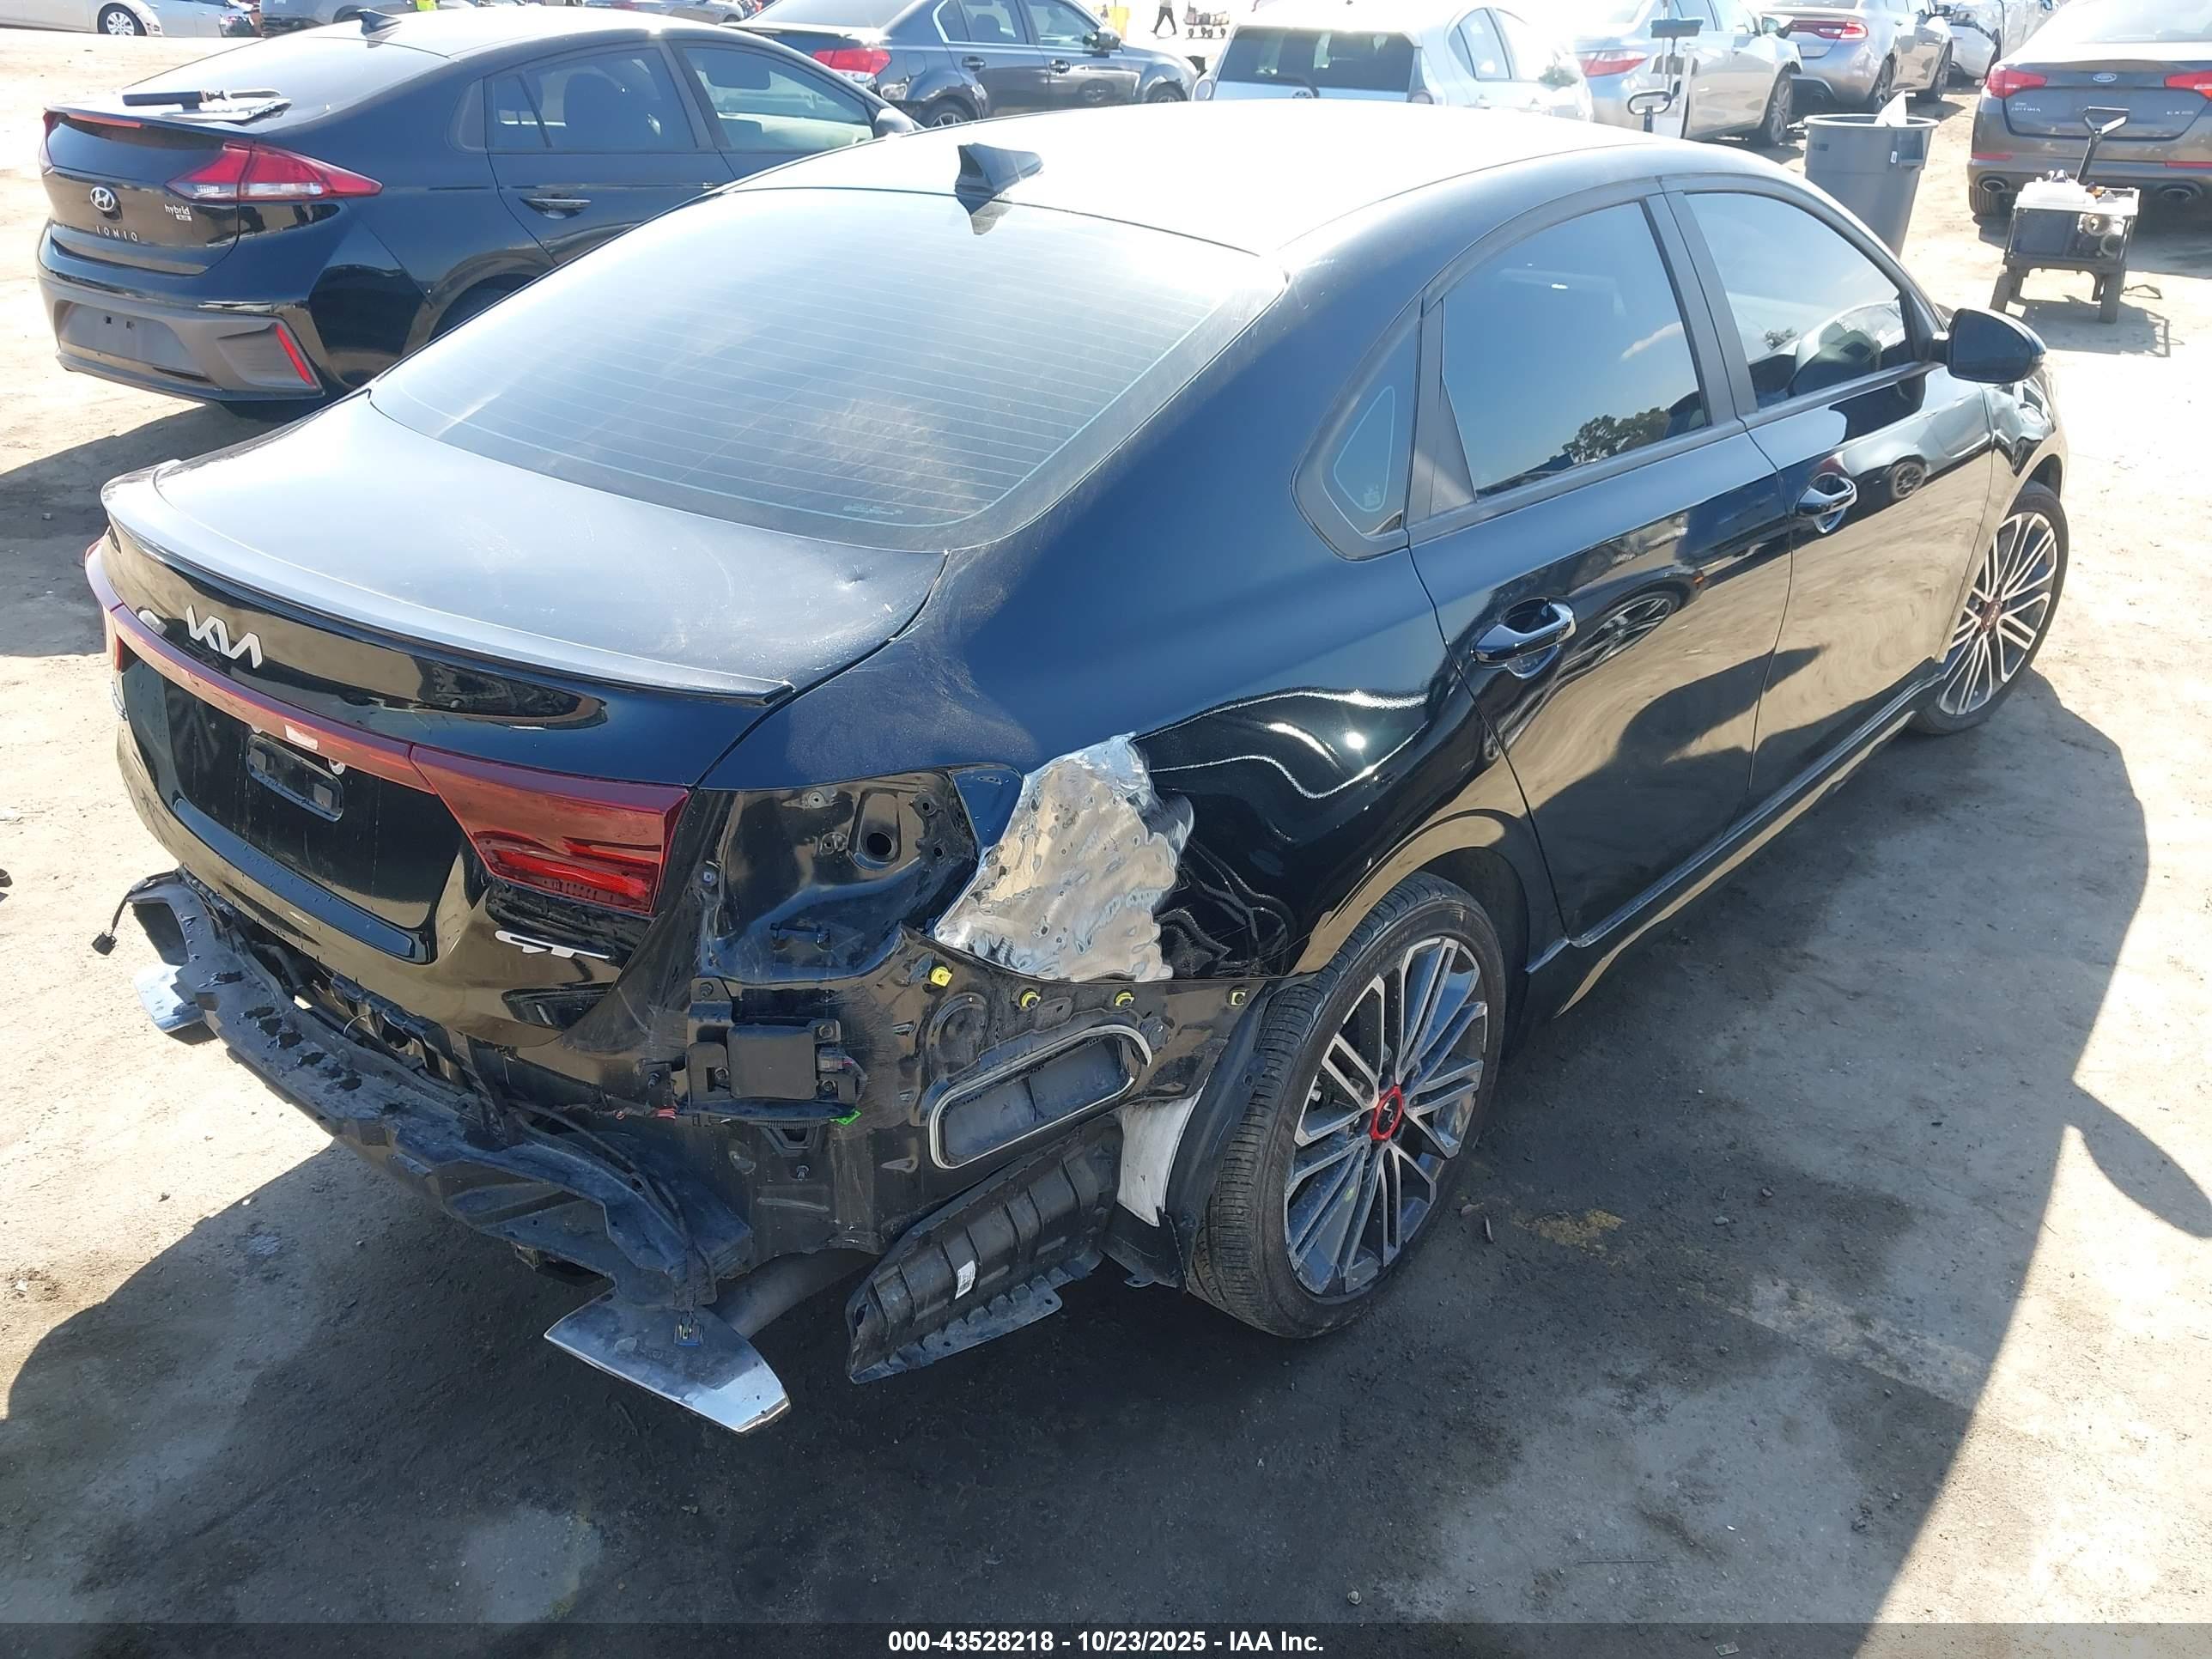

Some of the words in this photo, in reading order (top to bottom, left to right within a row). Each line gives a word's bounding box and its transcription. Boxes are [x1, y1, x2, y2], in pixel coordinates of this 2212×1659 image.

[164, 204, 191, 216] hybrid
[96, 225, 138, 241] IONIQ
[185, 605, 263, 669] KIA
